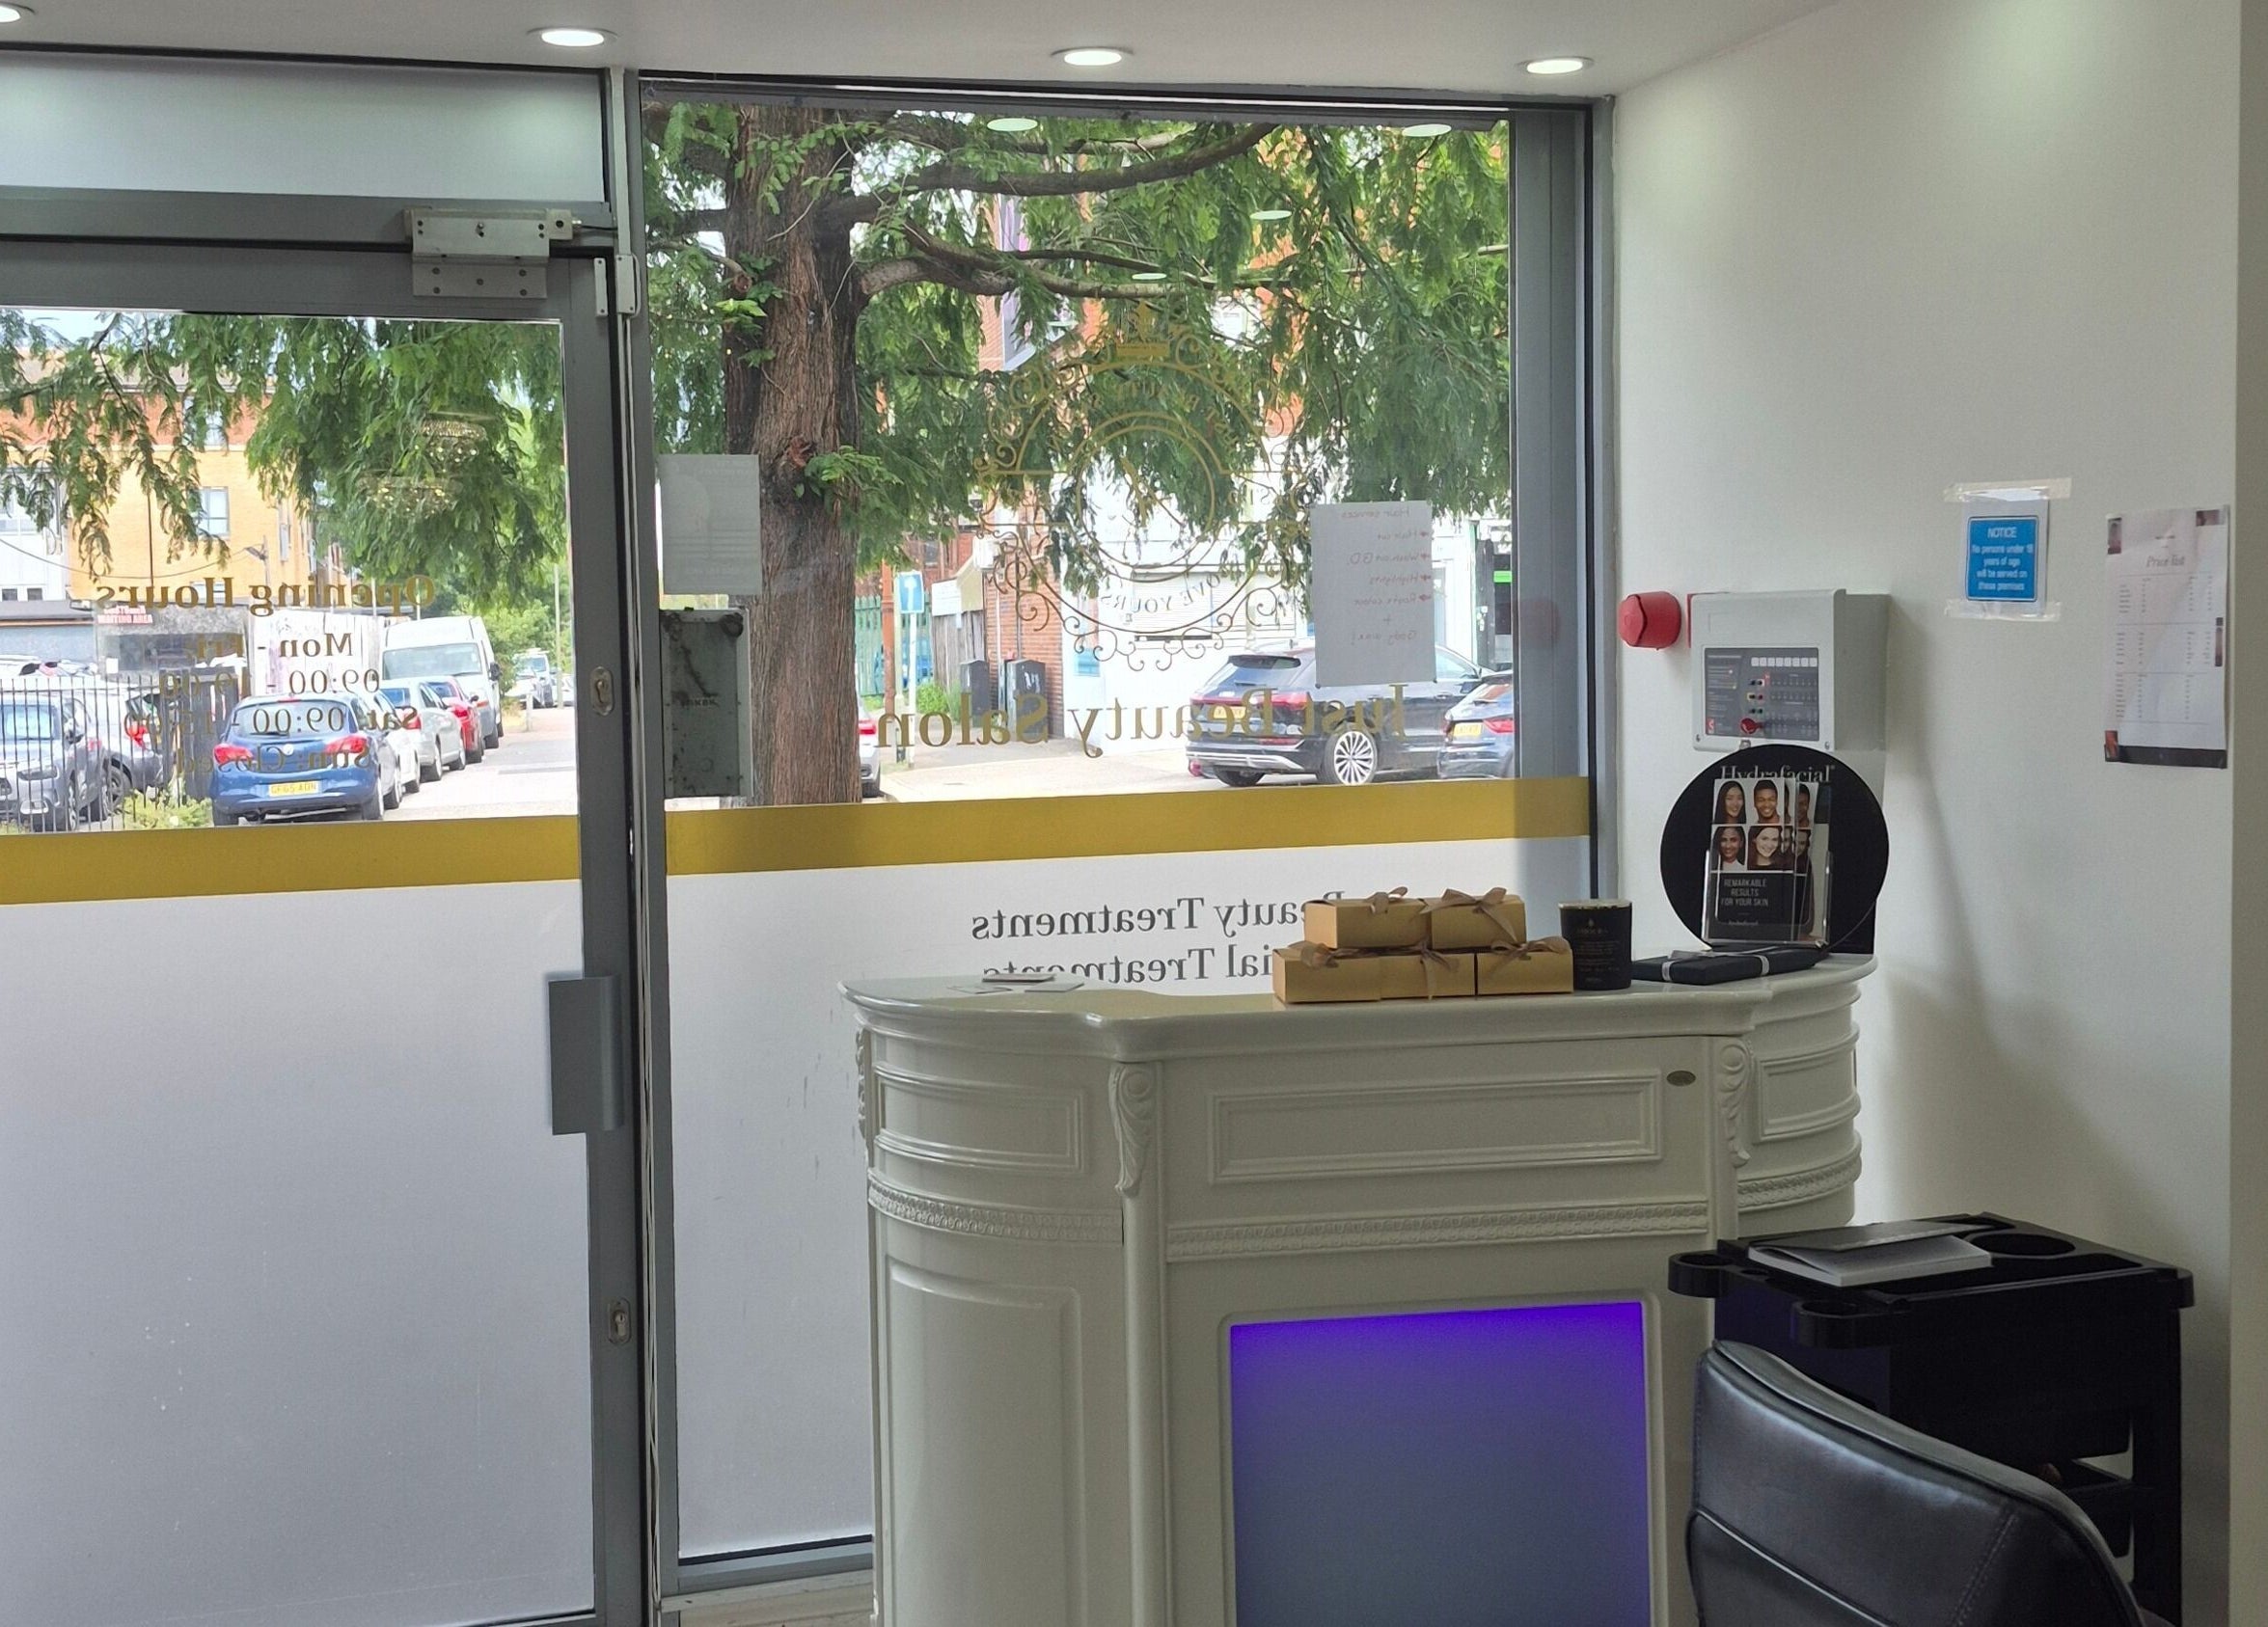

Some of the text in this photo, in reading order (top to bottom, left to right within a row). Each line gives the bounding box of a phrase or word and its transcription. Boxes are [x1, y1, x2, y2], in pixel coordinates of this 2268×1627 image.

[1987, 527, 2017, 538] NOTICE
[1723, 879, 1768, 887] REMARKABLE
[1731, 887, 1760, 897] RESULTS
[1735, 897, 1752, 907] YOUR
